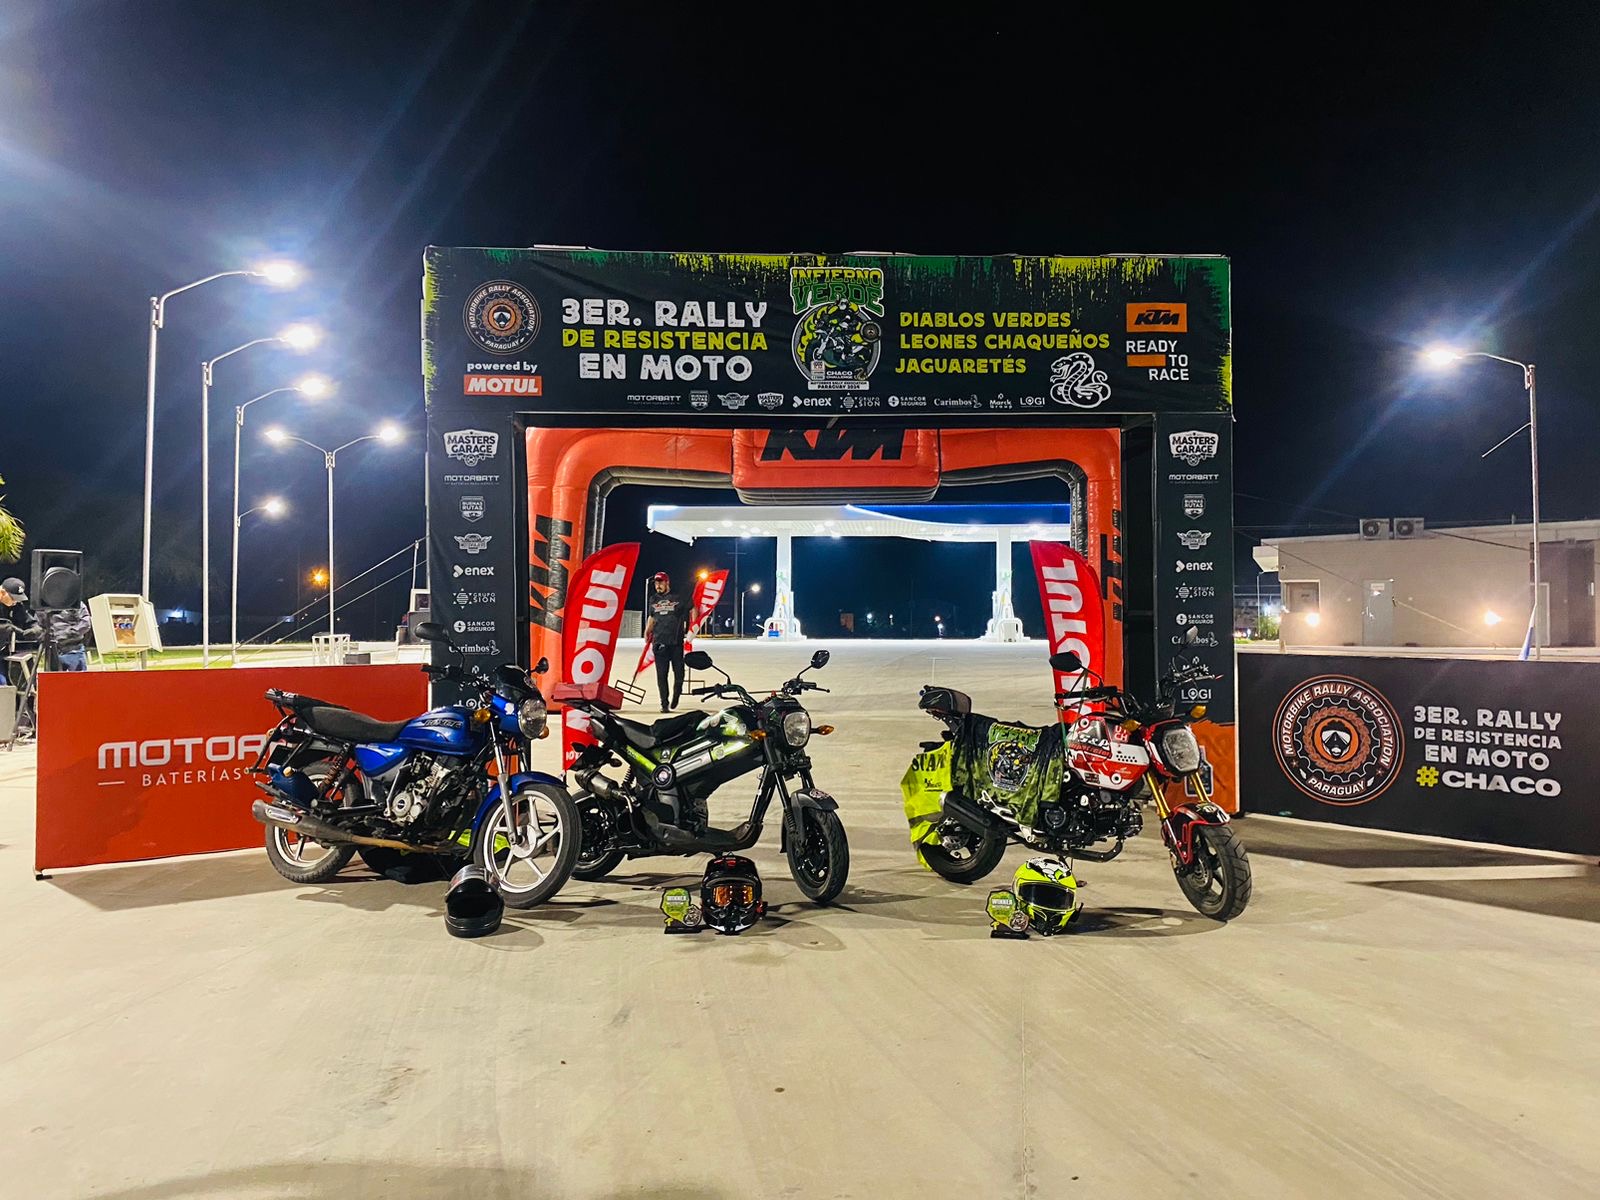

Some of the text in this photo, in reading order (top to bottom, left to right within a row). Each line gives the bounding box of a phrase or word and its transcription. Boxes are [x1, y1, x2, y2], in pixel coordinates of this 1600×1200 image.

[791, 269, 882, 287] INFIERNO
[792, 282, 884, 316] VERDE
[469, 284, 536, 332] MOTORBIKE RALLY ASSOCIATION
[562, 297, 768, 328] 3ER. RALLY
[899, 311, 1071, 327] DIABLOS VERDES
[1134, 309, 1180, 325] KTM
[485, 339, 520, 350] PARAGUAY
[562, 328, 768, 351] DE RESISTENCIA
[900, 328, 1110, 350] LEONES CHAQUEÑOS
[1125, 340, 1178, 353] READY
[466, 361, 538, 374] powered by
[579, 352, 753, 382] EN MOTO
[895, 353, 1027, 374] JAGUARETÉS
[1168, 354, 1189, 367] TO
[1148, 368, 1190, 381] RACE
[467, 377, 539, 394] MOTUL
[627, 394, 681, 402] MOTORBATT
[803, 397, 832, 407] enex
[933, 397, 973, 406] Carimbos
[1019, 396, 1046, 406] LOGI
[447, 435, 496, 445] MASTERS
[1172, 436, 1216, 445] MASTERS
[451, 444, 493, 454] GARAGE
[1175, 445, 1213, 454] GARAGE
[464, 566, 495, 576] enex
[1185, 561, 1214, 571] enex
[1171, 635, 1209, 644] Cbos
[448, 644, 491, 653] rimbos
[1181, 689, 1212, 700] LOGI
[1282, 684, 1393, 767] MOTORBIKE RALLY ASSOCIATION
[1414, 705, 1562, 731] 3ER. RALLY
[1413, 726, 1562, 750] DE RESISTENCIA
[97, 734, 285, 770] MOTOR
[1425, 744, 1550, 771] EN MOTO
[142, 766, 242, 787] BATERÍAS
[1415, 765, 1562, 797] #CHACO
[1308, 777, 1366, 796] PARAGUAY
